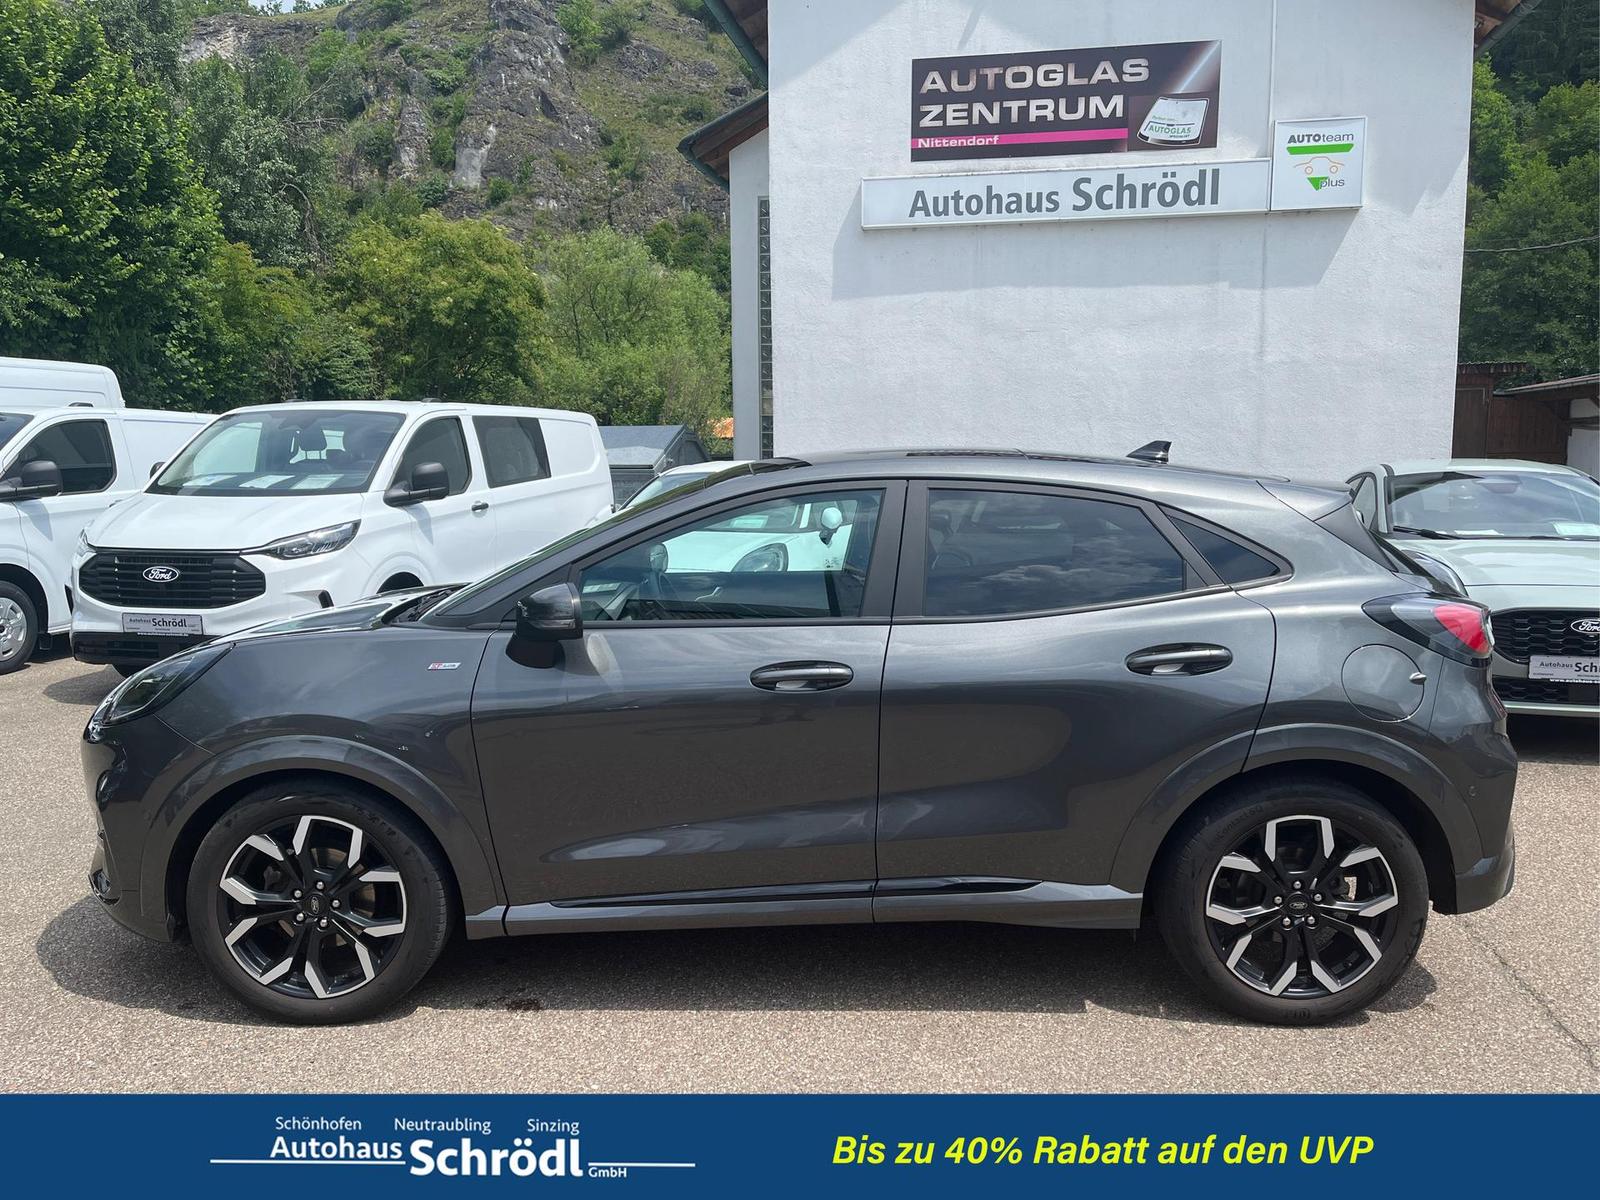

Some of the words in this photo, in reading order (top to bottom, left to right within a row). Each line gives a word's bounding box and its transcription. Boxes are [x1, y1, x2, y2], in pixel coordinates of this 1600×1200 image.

[920, 58, 1150, 94] AUTOGLAS
[919, 94, 1124, 127] ZENTRUM
[1149, 125, 1192, 134] AUTOGLAS
[918, 135, 999, 148] Nittendorf
[1287, 133, 1354, 143] AUTOteam
[1320, 179, 1345, 189] plus
[908, 185, 1060, 218] Autohaus
[1072, 168, 1220, 212] Schrödl
[148, 568, 173, 580] Ford
[152, 618, 187, 627] Schrödl
[1574, 662, 1600, 673] Sch
